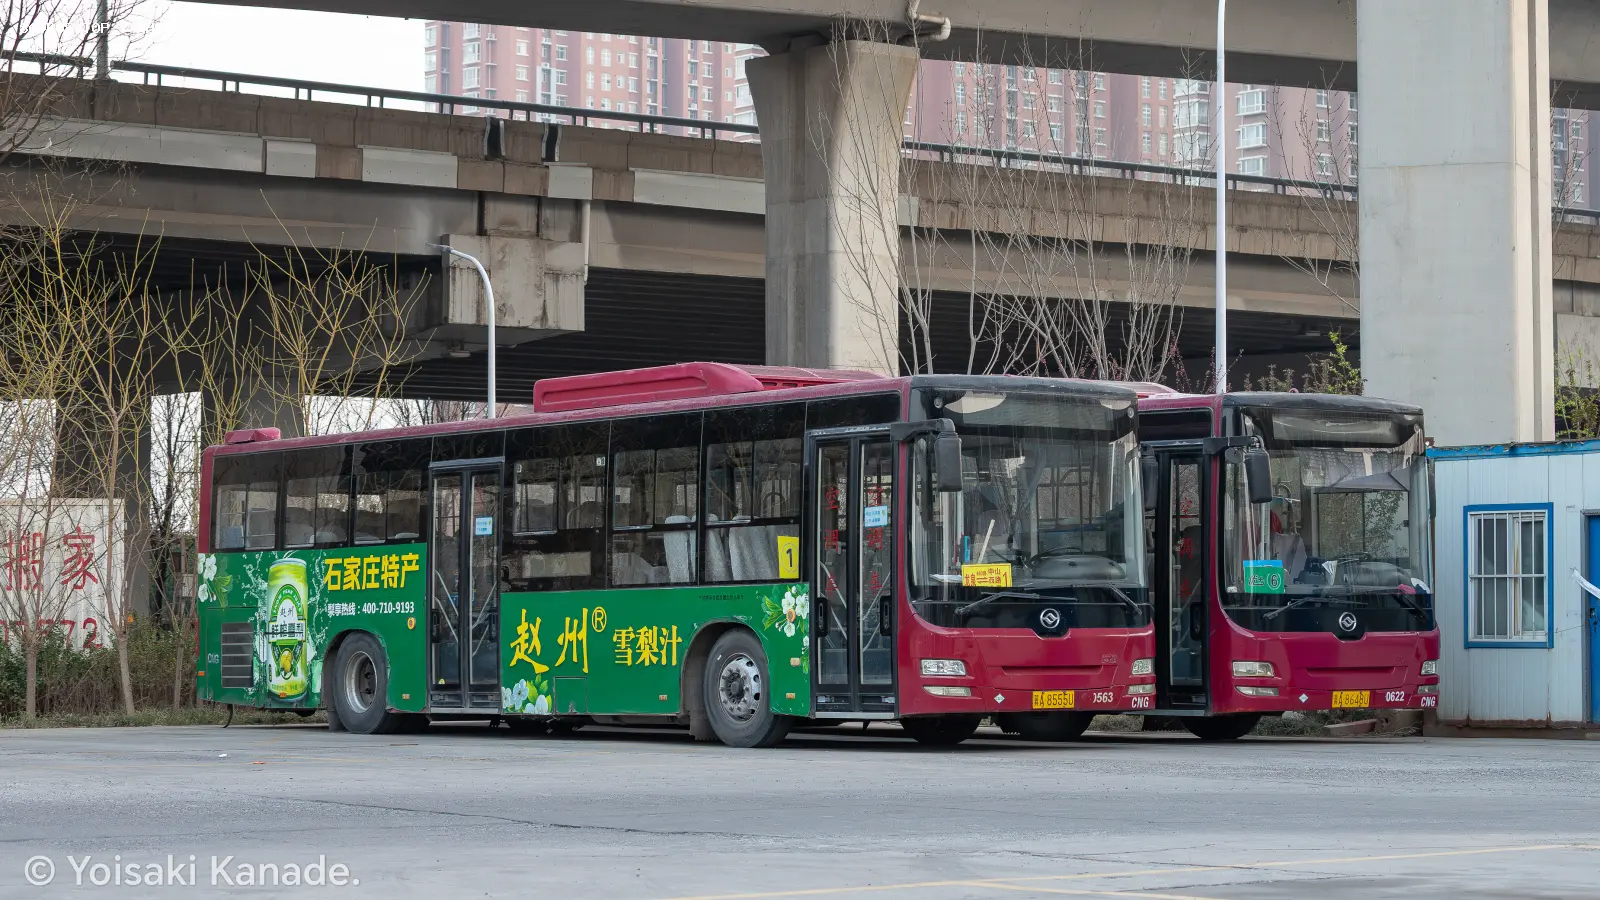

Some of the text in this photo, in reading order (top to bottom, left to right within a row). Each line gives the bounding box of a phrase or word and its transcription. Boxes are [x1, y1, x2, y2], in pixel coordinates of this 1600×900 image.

[786, 547, 793, 568] 1
[323, 552, 419, 591] 石家庄特产
[510, 608, 588, 674] 赵州
[613, 625, 683, 666] 雪梨汁
[1131, 697, 1149, 708] CNG
[1385, 691, 1405, 702] 0622
[1420, 696, 1436, 707] CNG
